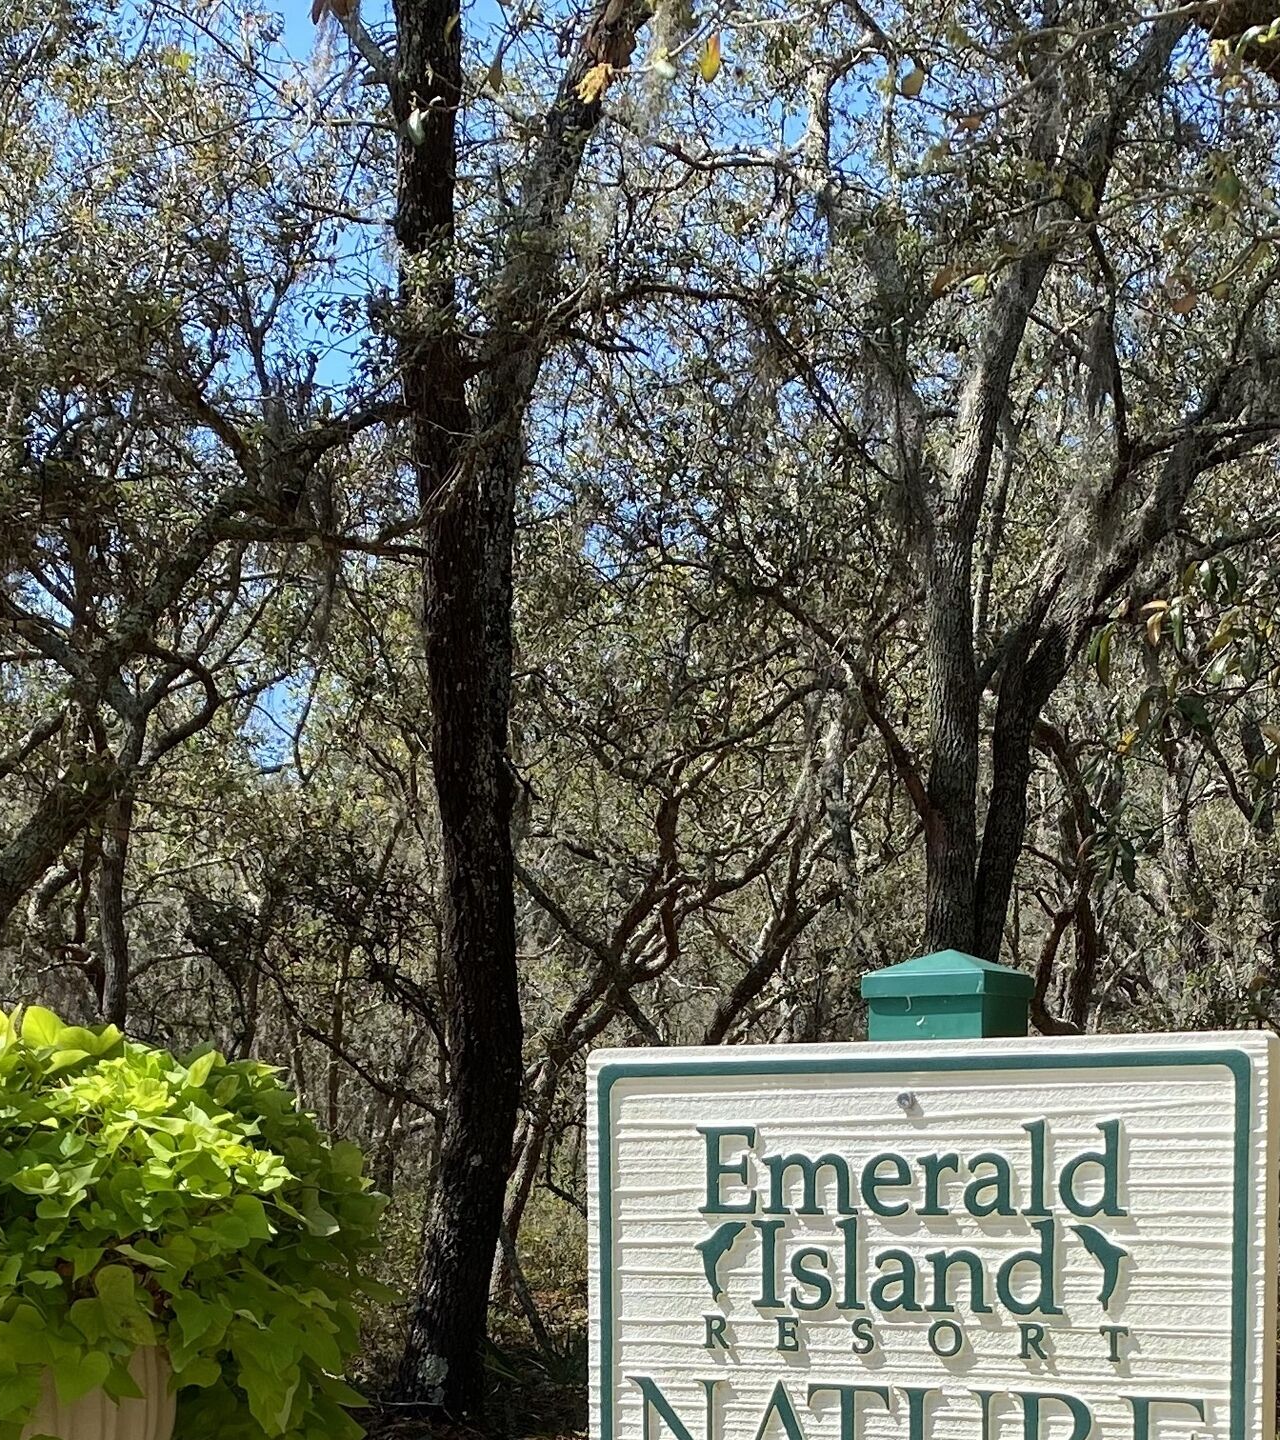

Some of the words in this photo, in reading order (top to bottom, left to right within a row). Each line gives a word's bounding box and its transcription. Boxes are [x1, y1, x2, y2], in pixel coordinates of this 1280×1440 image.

[697, 1120, 1127, 1217] Emerald
[751, 1219, 1063, 1315] Island
[704, 1316, 1128, 1362] RESORT
